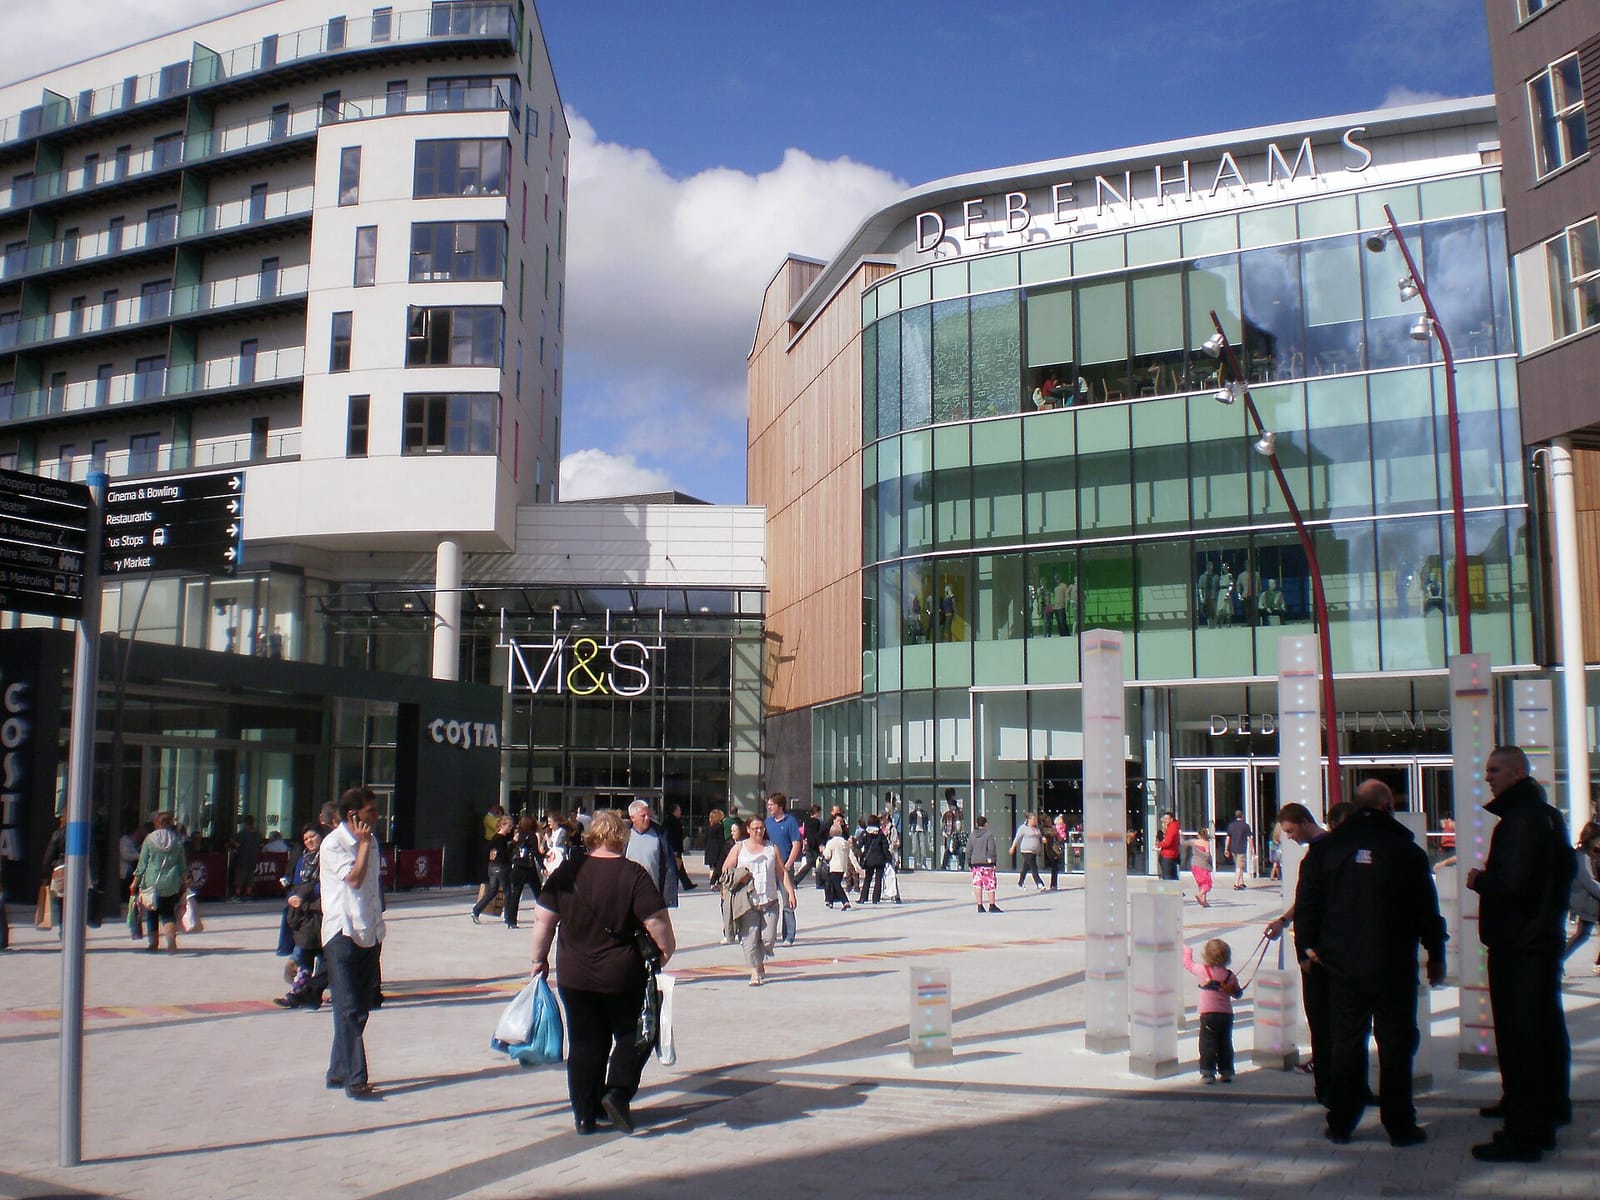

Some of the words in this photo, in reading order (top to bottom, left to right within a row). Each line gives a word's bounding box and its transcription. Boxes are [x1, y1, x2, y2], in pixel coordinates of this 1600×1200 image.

[915, 127, 1373, 254] DEBENHAMS
[0, 477, 36, 495] hopping
[38, 483, 68, 498] Centre
[107, 491, 137, 503] Cinema
[138, 488, 145, 499] &
[146, 485, 179, 498] Bowling
[106, 511, 152, 525] Restaurants
[10, 525, 52, 541] Museums
[121, 535, 144, 548] Stops
[0, 546, 17, 559] hire
[20, 550, 54, 567] Railway
[123, 556, 151, 569] Market
[10, 571, 50, 587] Metrolink
[508, 638, 650, 696] M&S
[430, 718, 498, 749] COSTA
[1210, 710, 1449, 736] DEBHAMS
[0, 682, 29, 861] COSTA
